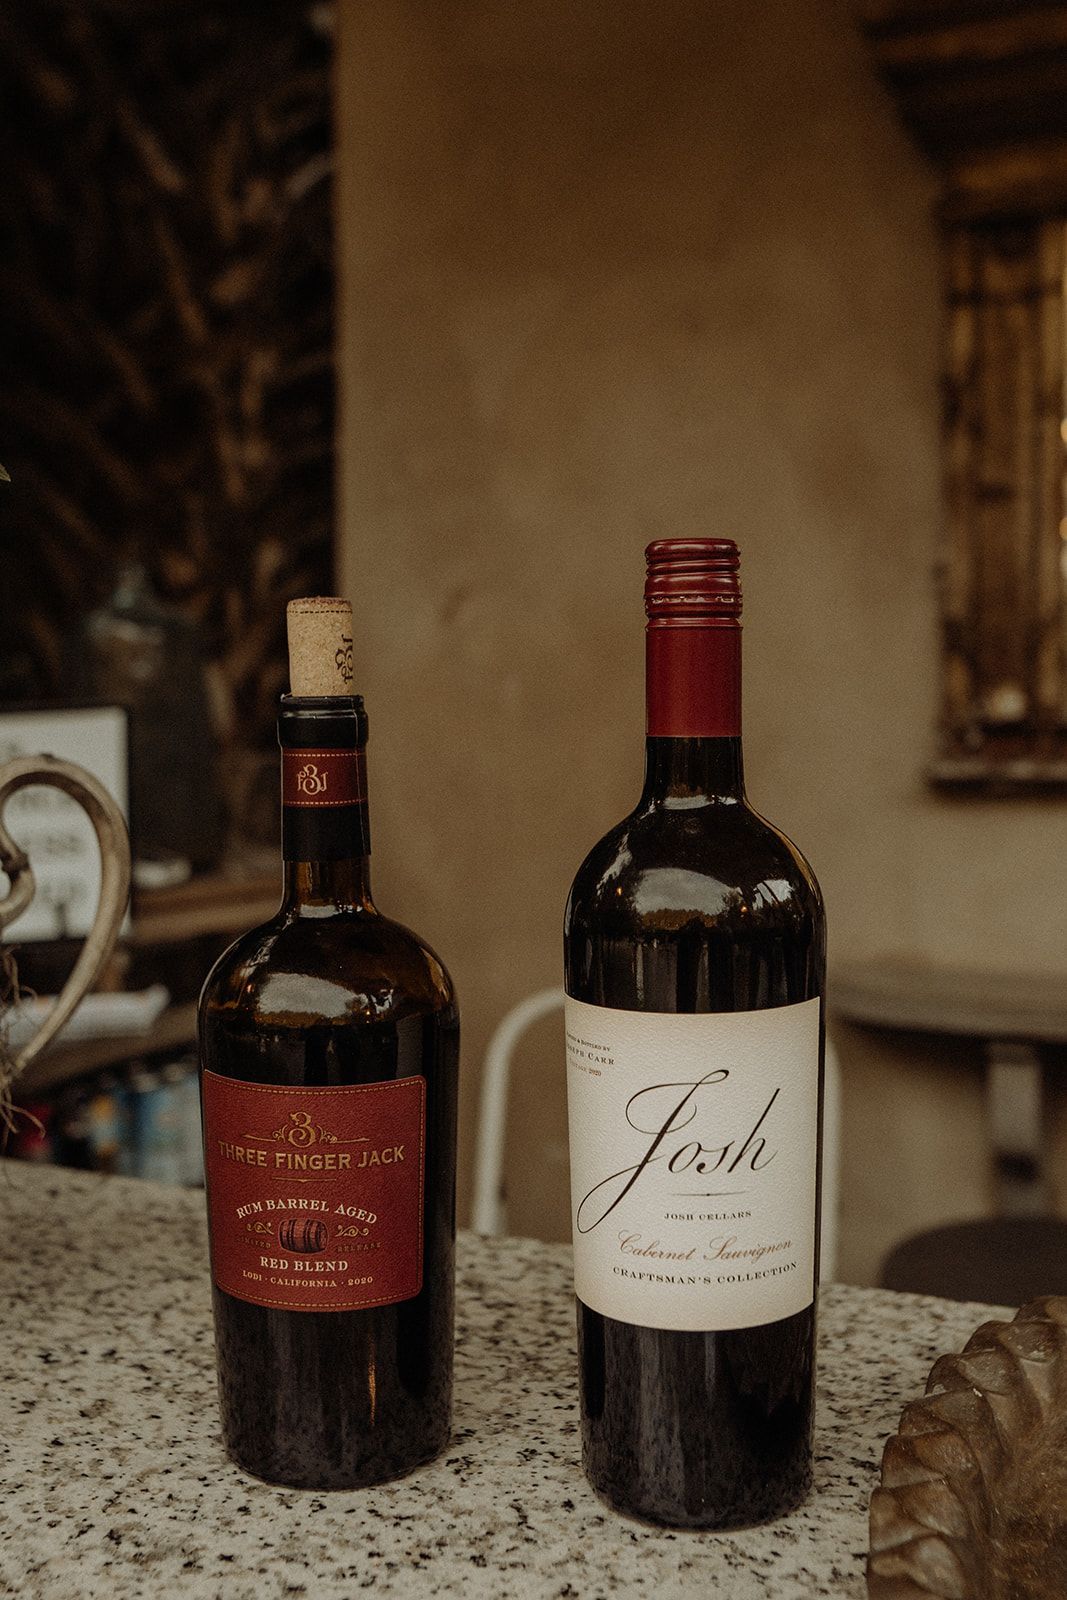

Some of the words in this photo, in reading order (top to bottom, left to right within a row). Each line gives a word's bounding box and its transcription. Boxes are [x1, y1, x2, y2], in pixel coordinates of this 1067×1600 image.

[217, 1140, 268, 1168] THREE
[275, 1152, 352, 1170] FINGER
[356, 1145, 405, 1169] JACK
[577, 1069, 780, 1234] Josh
[236, 1202, 264, 1219] RUM
[265, 1198, 330, 1212] BARREL
[334, 1203, 378, 1225] AGED
[664, 1212, 695, 1221] JOSH
[698, 1210, 752, 1221] CELLARS
[617, 1229, 697, 1261] Cabernet
[702, 1235, 793, 1264] Sauvignon
[259, 1256, 290, 1270] RED
[294, 1259, 349, 1272] BLEND
[612, 1266, 712, 1285] CRAFTSMAN'S
[717, 1260, 799, 1284] COLLECTION
[242, 1270, 263, 1282] LODI
[269, 1276, 338, 1288] CALIFORNIA
[347, 1275, 374, 1286] 2020
